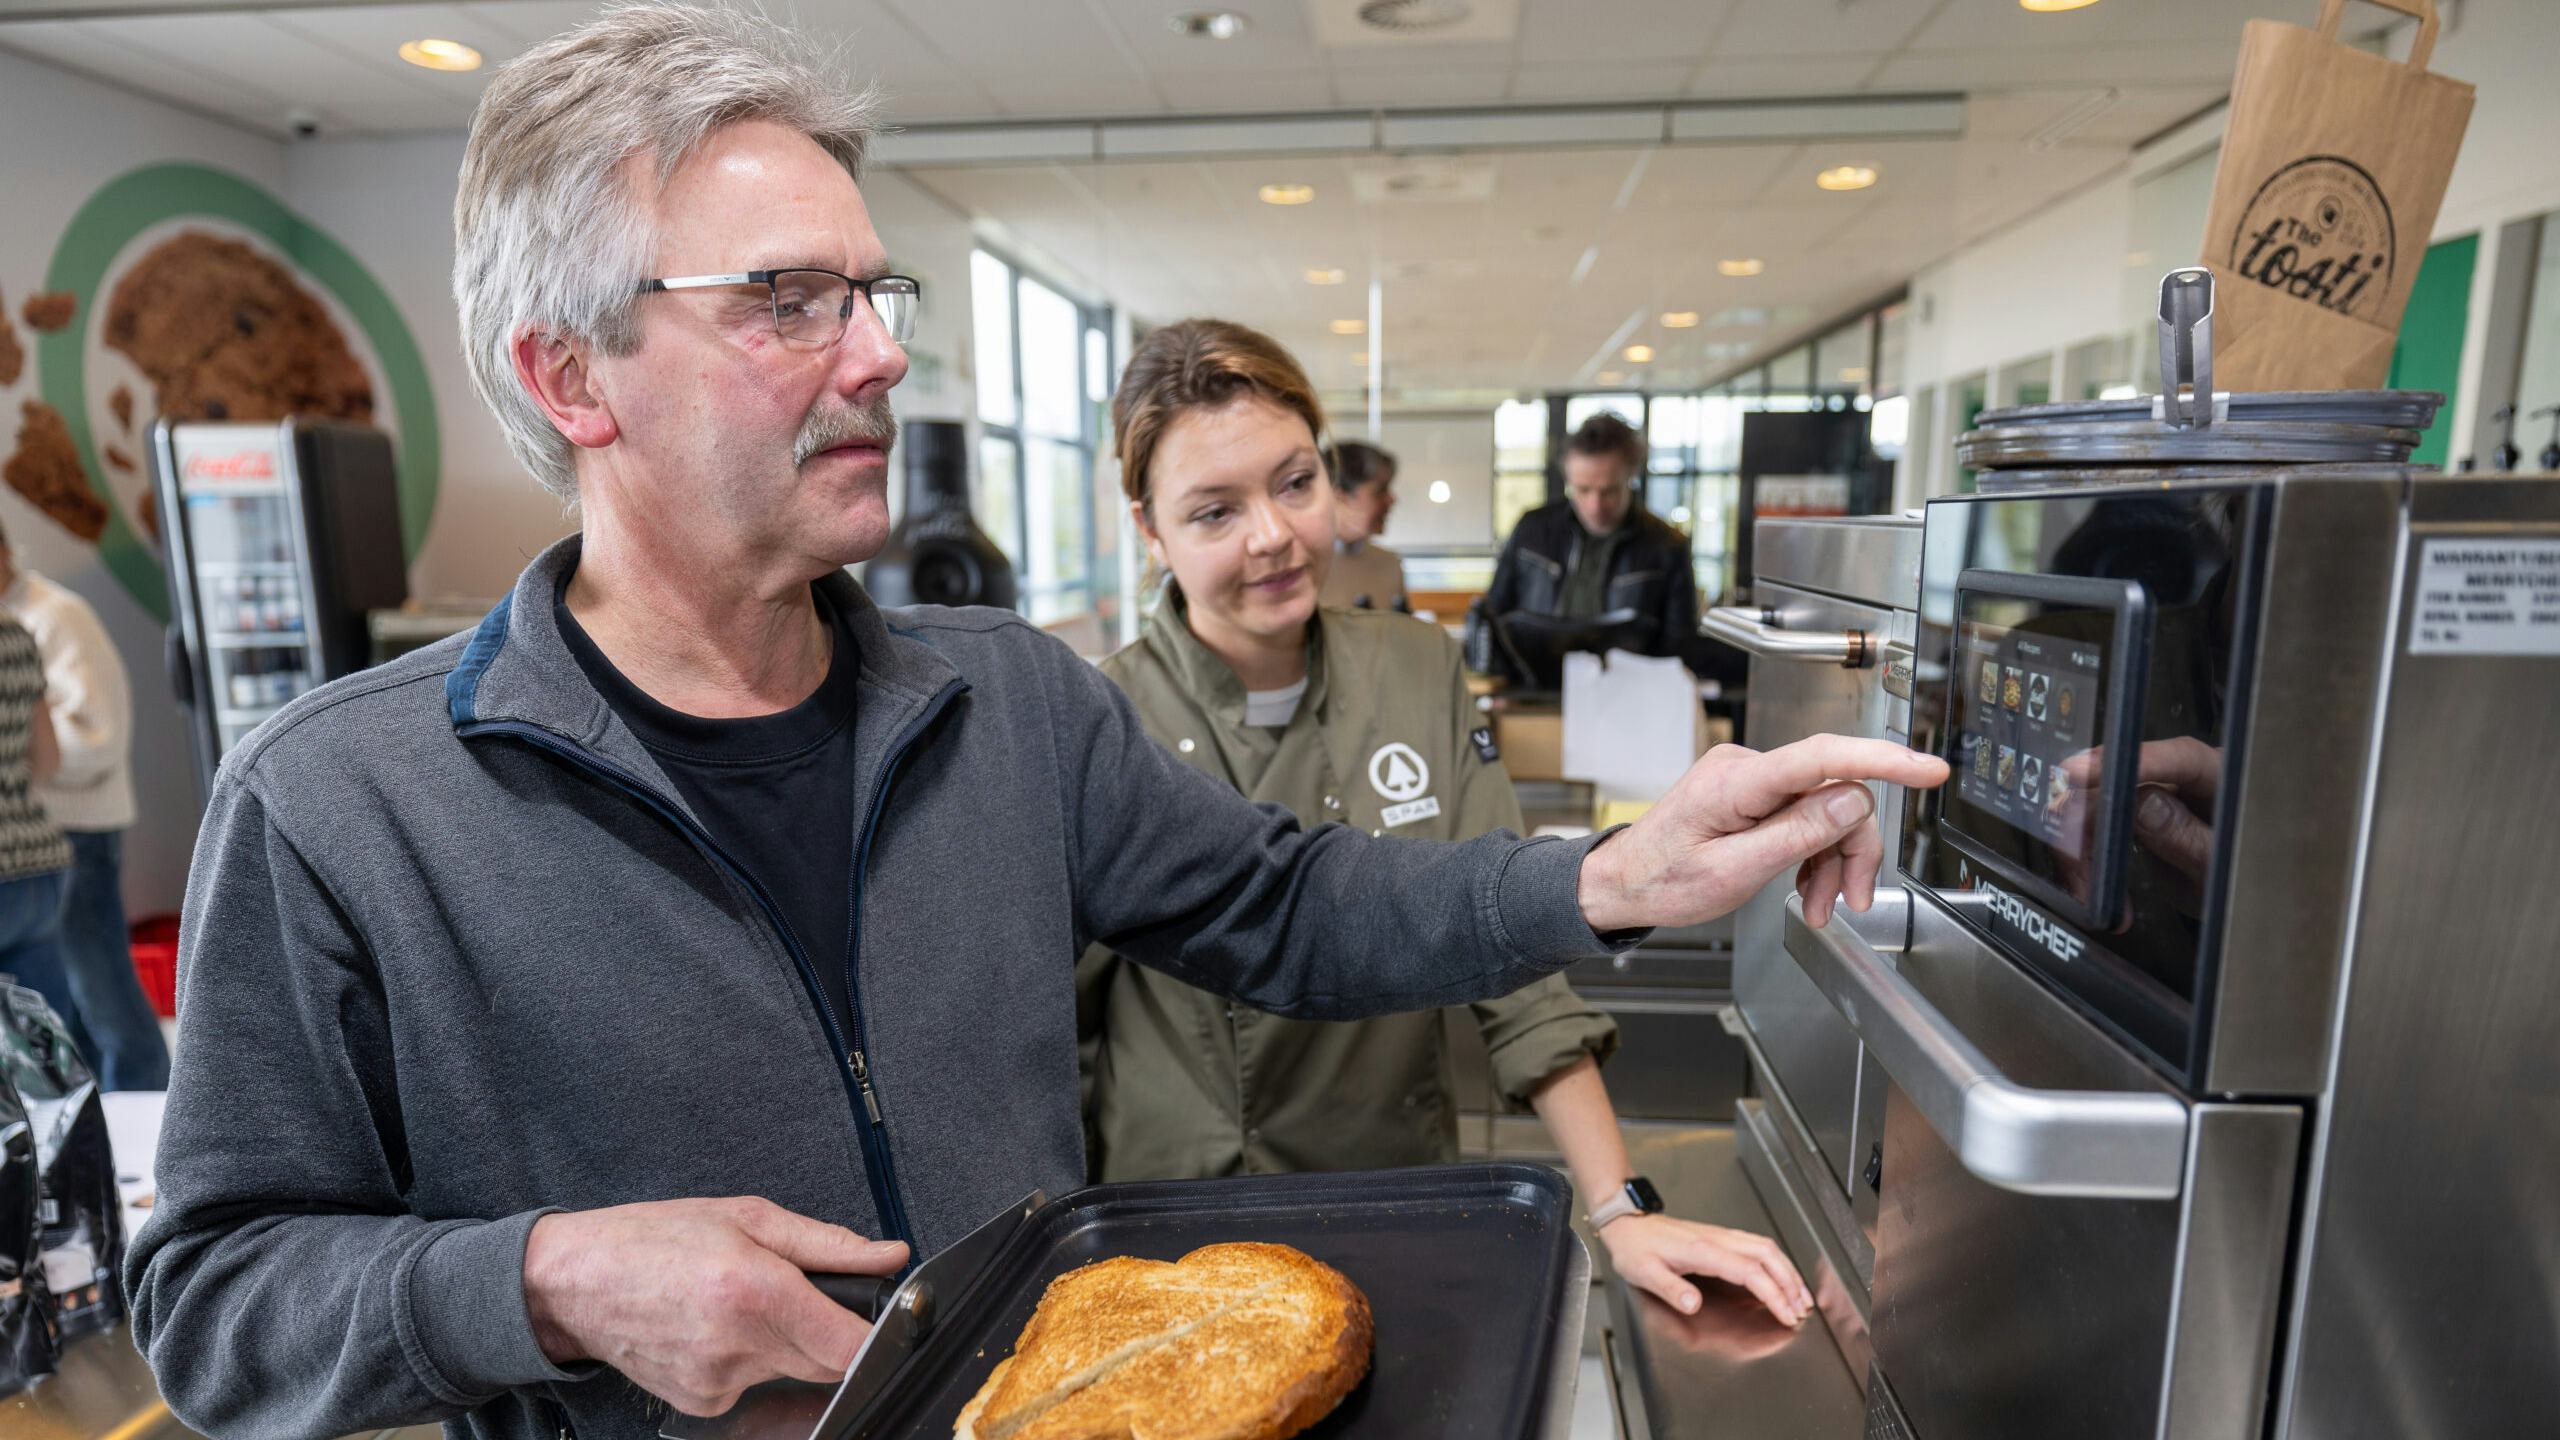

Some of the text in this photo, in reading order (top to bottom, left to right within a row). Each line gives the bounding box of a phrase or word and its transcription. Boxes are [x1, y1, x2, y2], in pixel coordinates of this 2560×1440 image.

[2287, 216, 2322, 246] The
[1387, 799, 1437, 821] SPAR
[1975, 874, 2083, 962] MERRYCHEF
